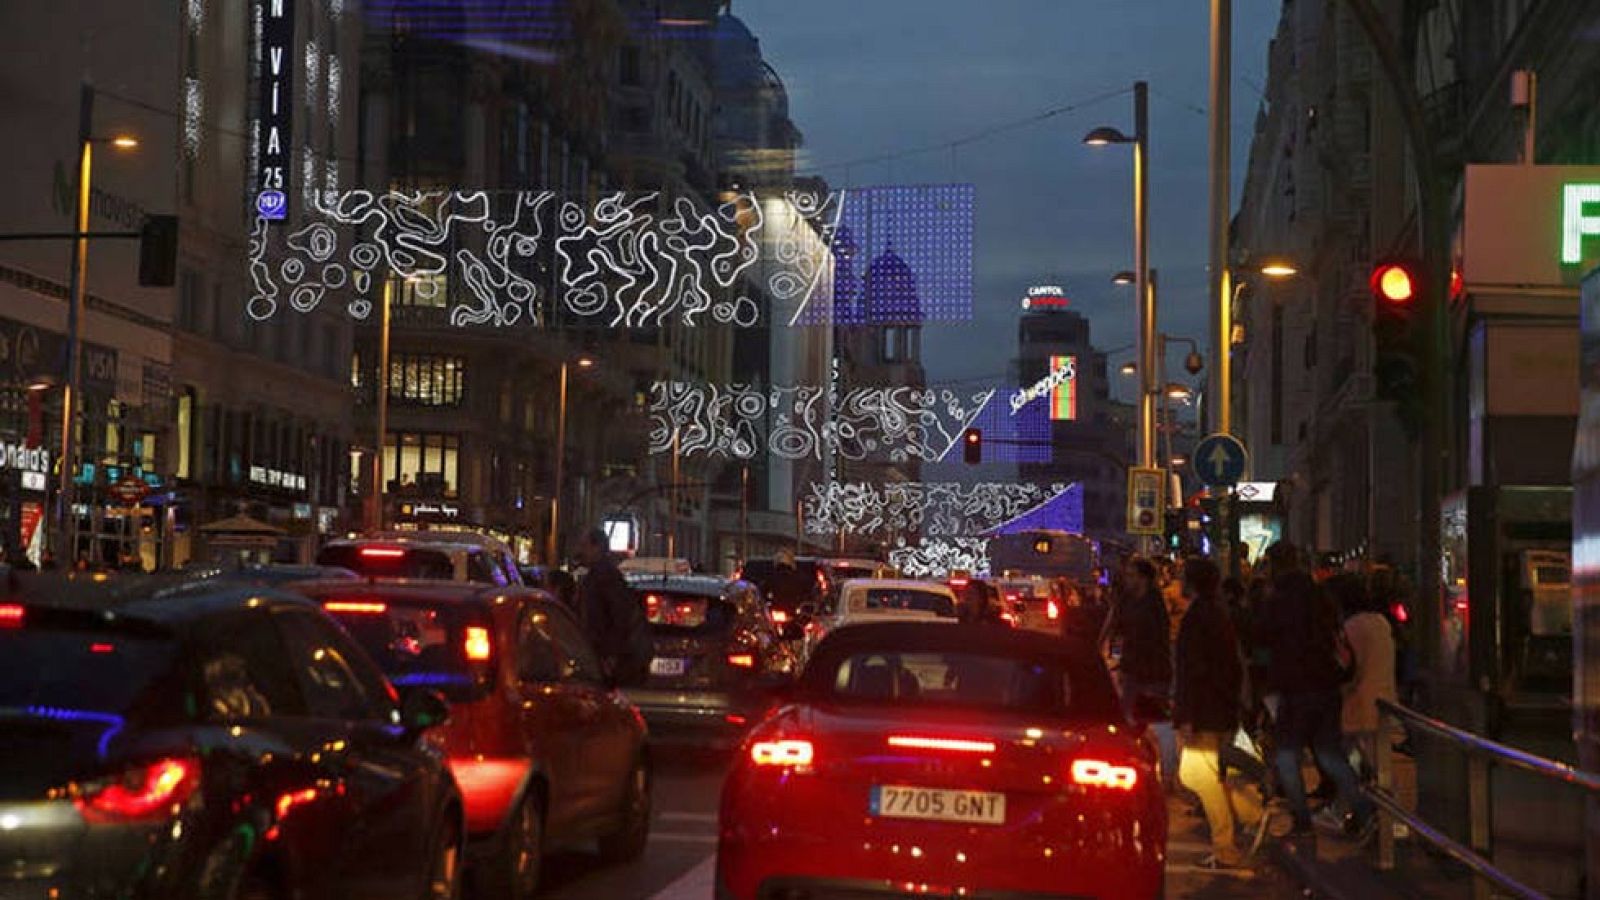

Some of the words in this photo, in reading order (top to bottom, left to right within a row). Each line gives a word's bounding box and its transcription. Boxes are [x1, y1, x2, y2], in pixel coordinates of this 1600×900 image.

[264, 167, 283, 188] 25
[884, 788, 945, 814] 7705
[953, 793, 1001, 817] GNT
